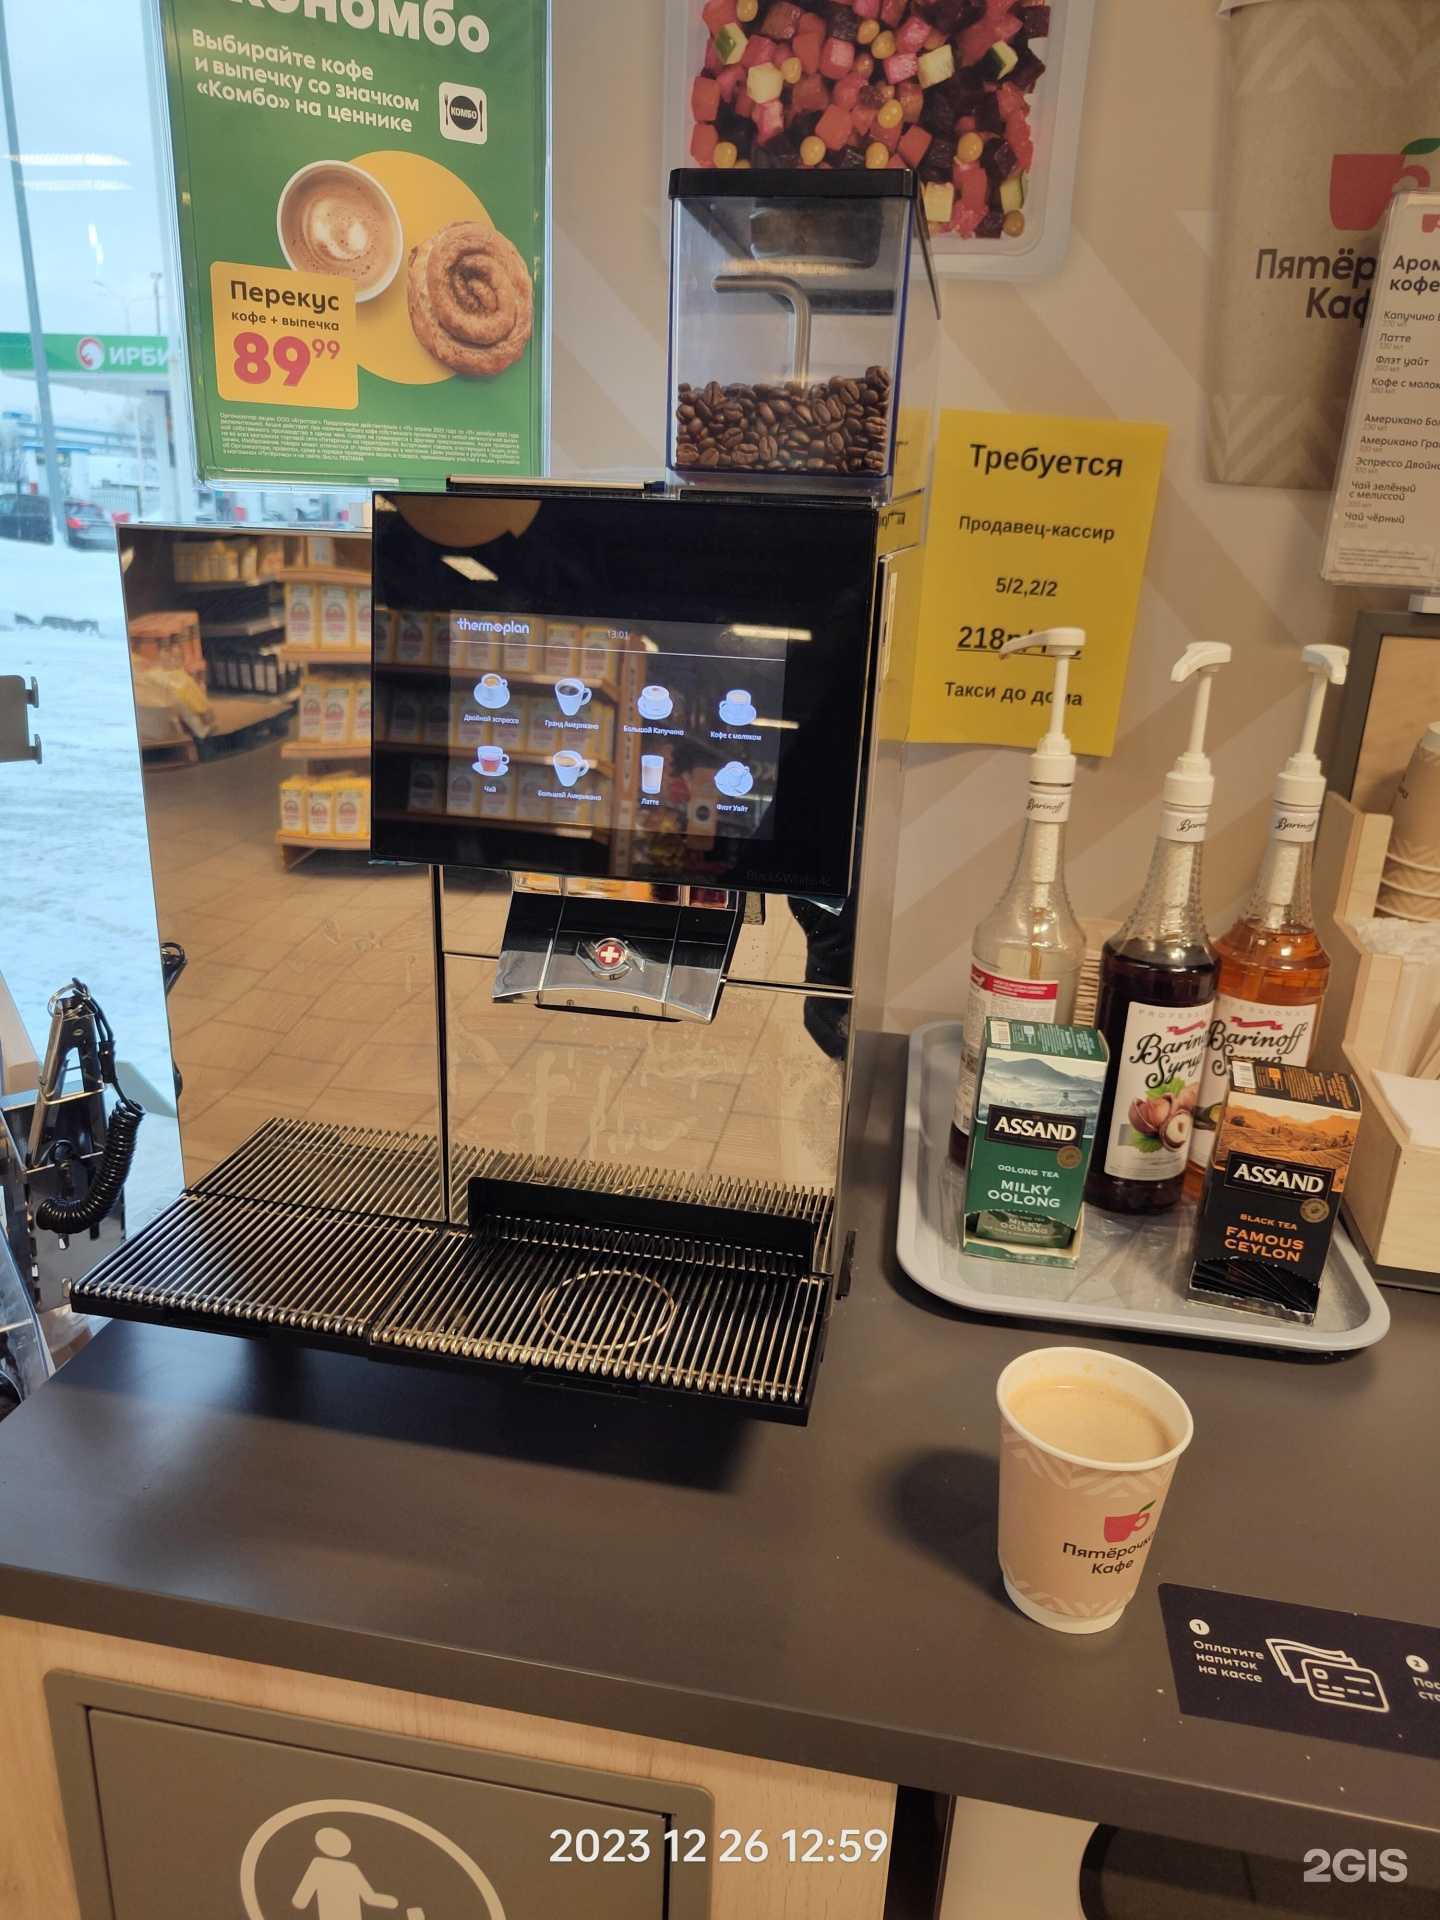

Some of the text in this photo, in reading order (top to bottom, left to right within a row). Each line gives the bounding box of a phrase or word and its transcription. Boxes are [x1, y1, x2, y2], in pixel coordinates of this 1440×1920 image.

[192, 28, 374, 81] Выбирайте кофе
[194, 56, 419, 112] и выпечку со значком
[196, 80, 412, 133] «Комбо» на ценнике
[450, 107, 478, 119] КОМБО
[1389, 276, 1440, 296] кофе
[231, 280, 339, 314] Перекус
[232, 311, 266, 325] кофе
[282, 317, 339, 331] выпечка
[1383, 310, 1435, 323] Капучино
[1379, 332, 1411, 343] Латте
[1375, 355, 1401, 366] Флэт
[1403, 356, 1429, 368] уайт
[1371, 377, 1398, 389] Кофе
[1400, 380, 1407, 388] с
[1364, 413, 1423, 426] Американо
[1360, 435, 1418, 448] Американо
[969, 443, 1123, 479] Требуется
[1356, 456, 1403, 469] Эспрессо
[1351, 480, 1371, 490] Чай
[1344, 511, 1364, 521] Чай
[958, 515, 1116, 544] Продавец-кассир
[995, 576, 1058, 598] 5/2,2/2
[456, 617, 530, 636] thermoplan
[945, 681, 1083, 707] Такси до доа
[710, 731, 727, 740] Кофе
[1207, 1020, 1308, 1055] Barinoff
[994, 1116, 1077, 1141] ASSAND
[998, 1164, 1060, 1178] OOLONG TEA
[1233, 1163, 1325, 1193] ASSAND
[1001, 1179, 1052, 1196] MILKY
[987, 1189, 1061, 1208] OOLONG
[1240, 1213, 1297, 1231] BLACK TEA
[1225, 1226, 1304, 1250] FAMOUS
[1225, 1238, 1301, 1263] CEYLON
[1092, 1560, 1134, 1574] Кафе
[1193, 1640, 1265, 1660] Оплатите
[1196, 1653, 1258, 1671] напиток
[1198, 1664, 1263, 1683] на кассе
